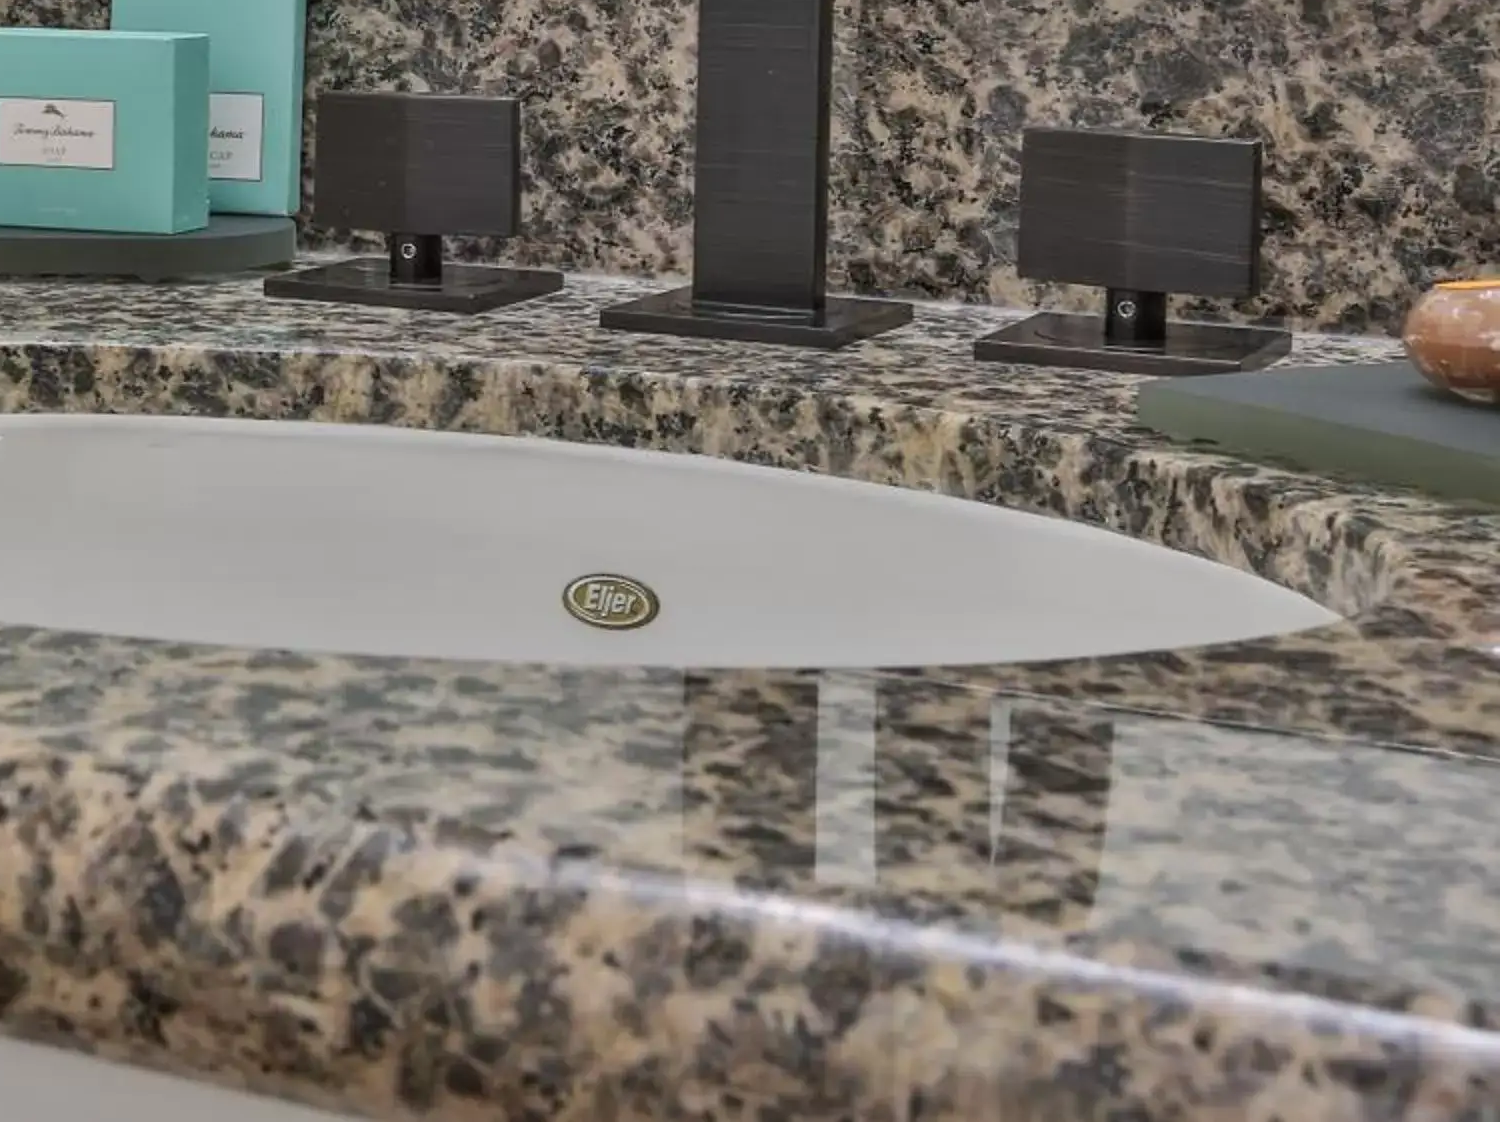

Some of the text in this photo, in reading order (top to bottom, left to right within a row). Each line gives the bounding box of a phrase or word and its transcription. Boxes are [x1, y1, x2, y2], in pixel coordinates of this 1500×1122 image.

[13, 123, 97, 139] Tommy Bahama
[209, 126, 245, 139] hama
[209, 150, 235, 161] OAP
[583, 582, 637, 617] Eljer
